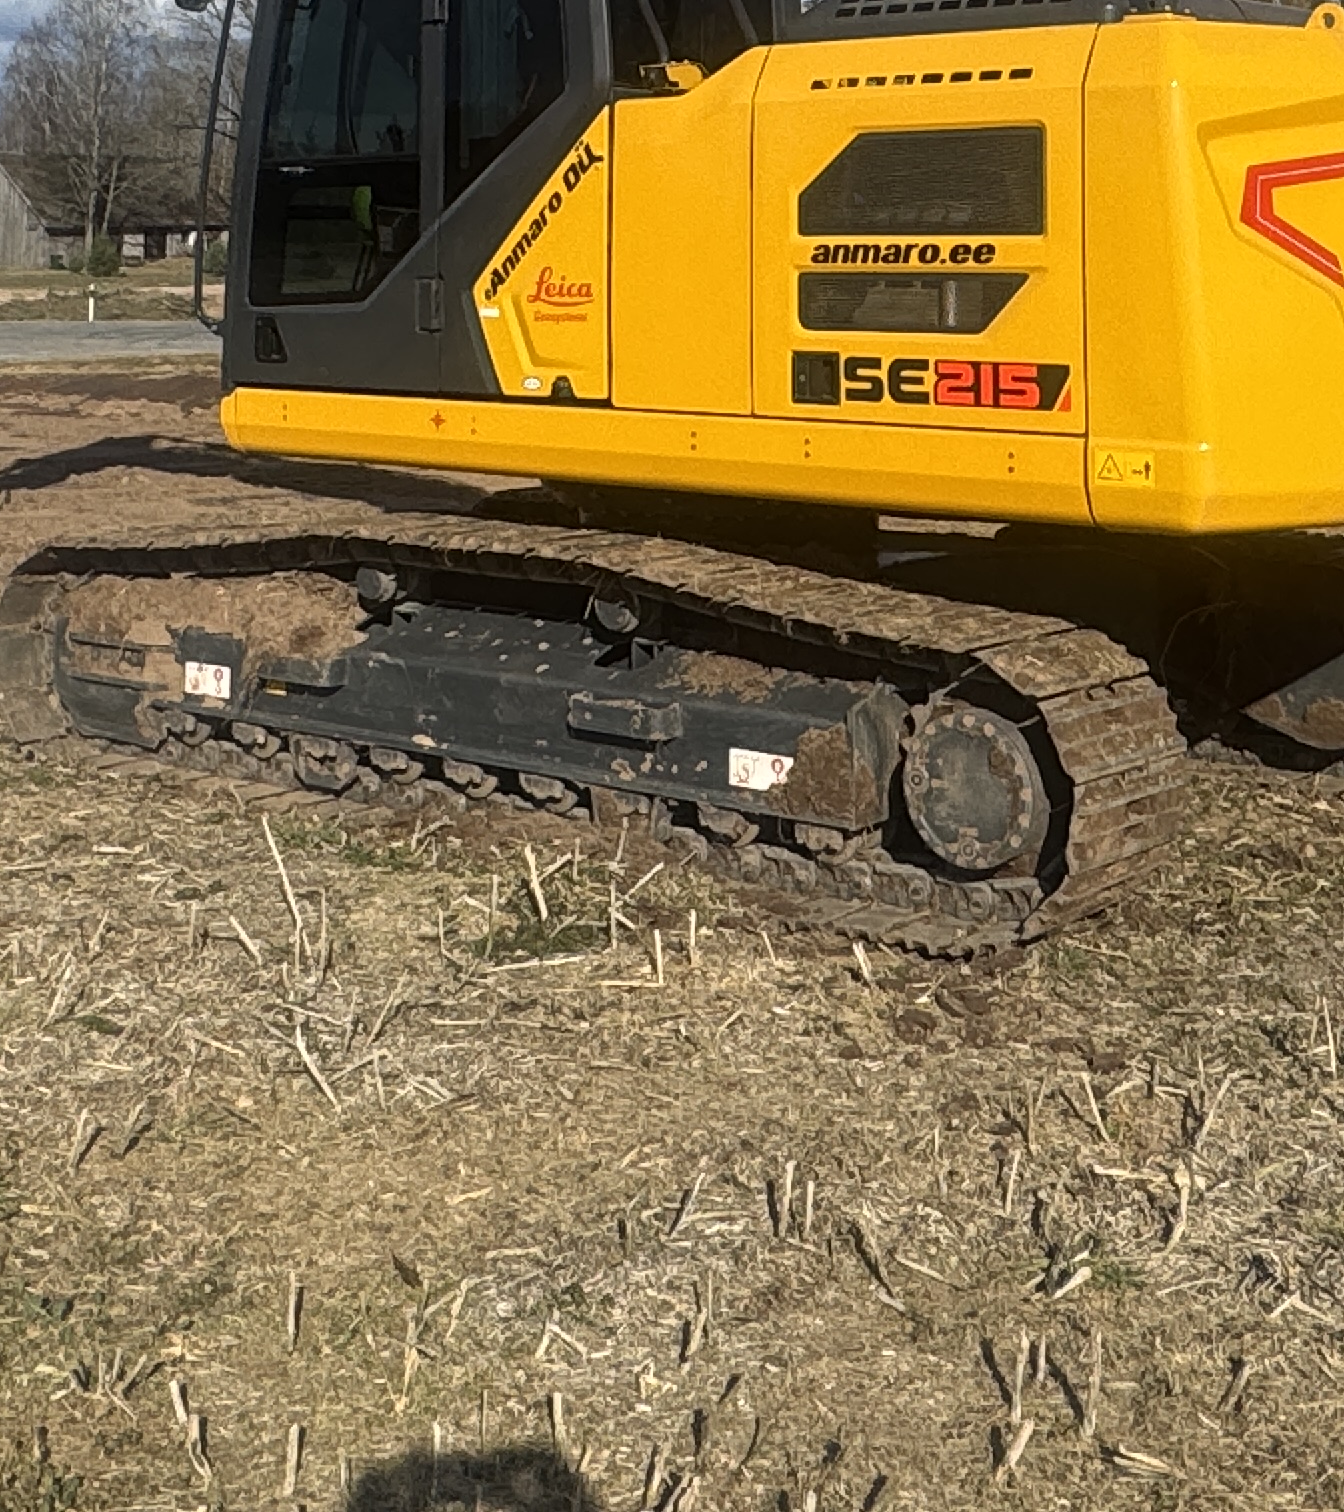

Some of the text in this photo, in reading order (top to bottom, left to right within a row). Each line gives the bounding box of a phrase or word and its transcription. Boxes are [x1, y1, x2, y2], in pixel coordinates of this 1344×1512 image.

[484, 190, 563, 302] Anmaro
[810, 242, 996, 265] anmaro.ee
[526, 265, 595, 308] Leica
[844, 356, 1041, 408] SE215
